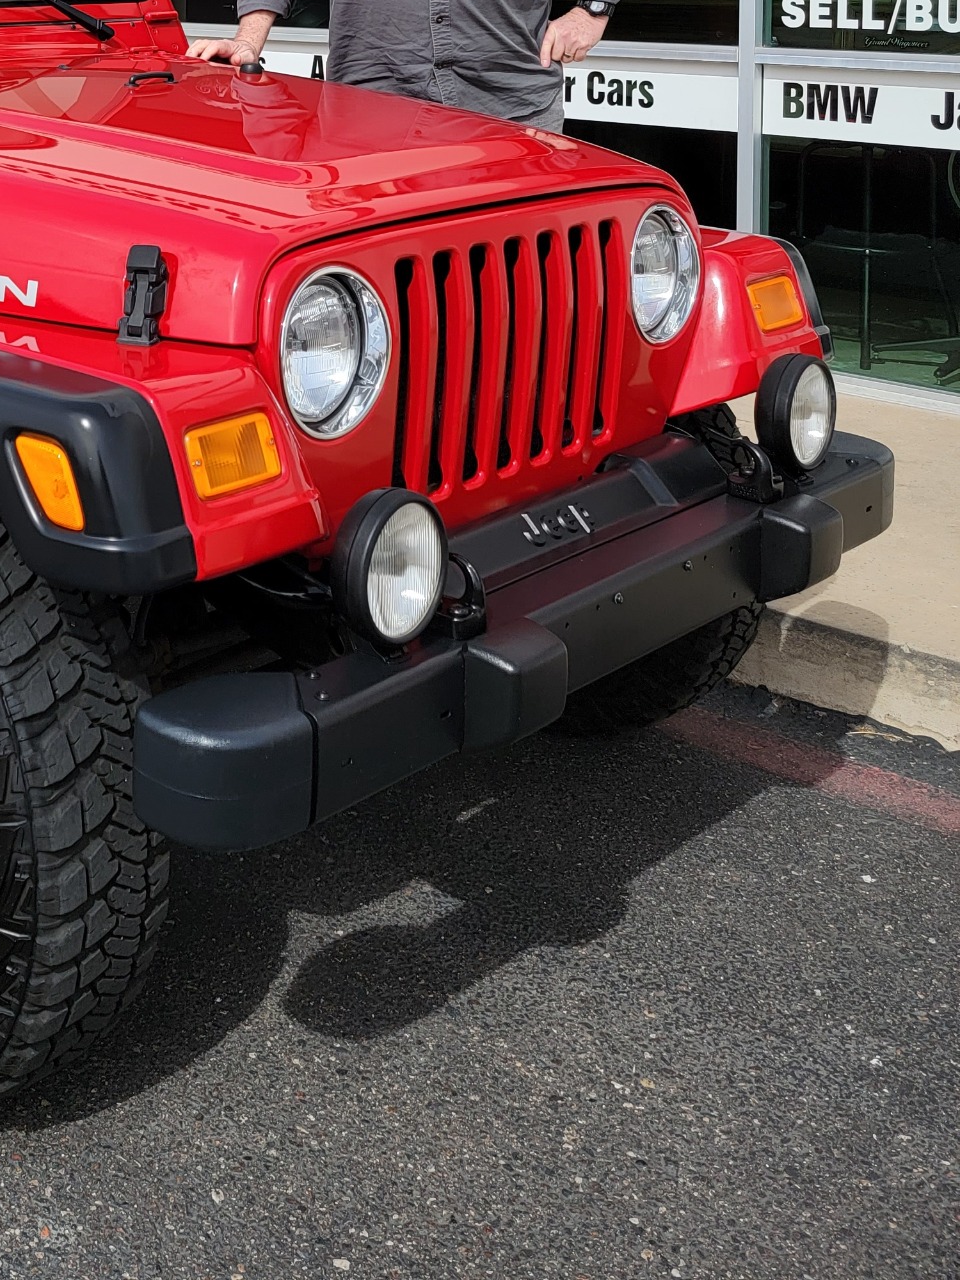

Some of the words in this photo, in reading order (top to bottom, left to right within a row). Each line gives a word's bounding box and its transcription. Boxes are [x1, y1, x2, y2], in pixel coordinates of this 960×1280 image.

[587, 71, 654, 108] Cars
[782, 82, 879, 124] BMW
[521, 505, 596, 547] Jeep
